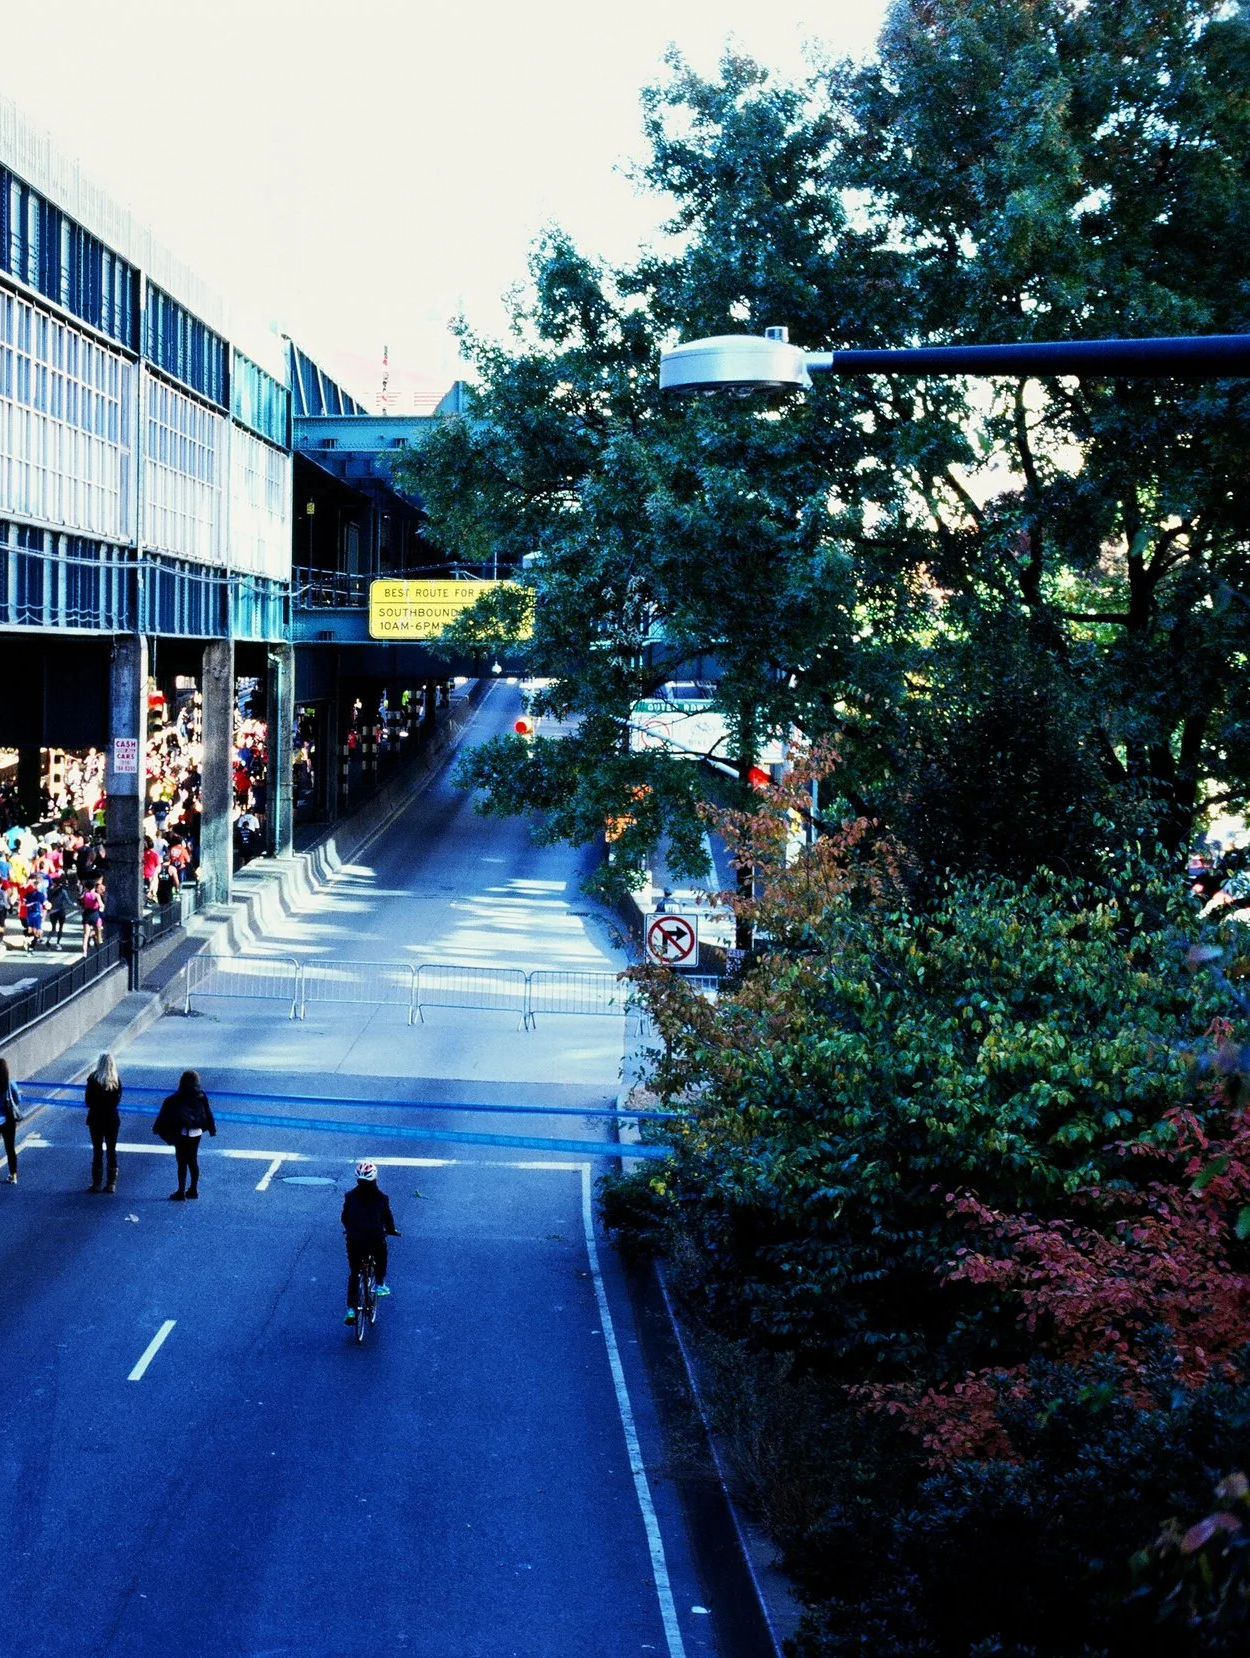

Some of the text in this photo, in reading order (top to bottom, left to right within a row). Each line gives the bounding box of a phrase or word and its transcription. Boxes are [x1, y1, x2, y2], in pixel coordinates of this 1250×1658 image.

[384, 588, 410, 598] BEST
[415, 588, 449, 598] ROUTE
[454, 588, 475, 598] FOR
[378, 608, 459, 618] SOUTHBOUND
[380, 621, 440, 631] 10AM-6PM
[116, 740, 136, 748] CASH
